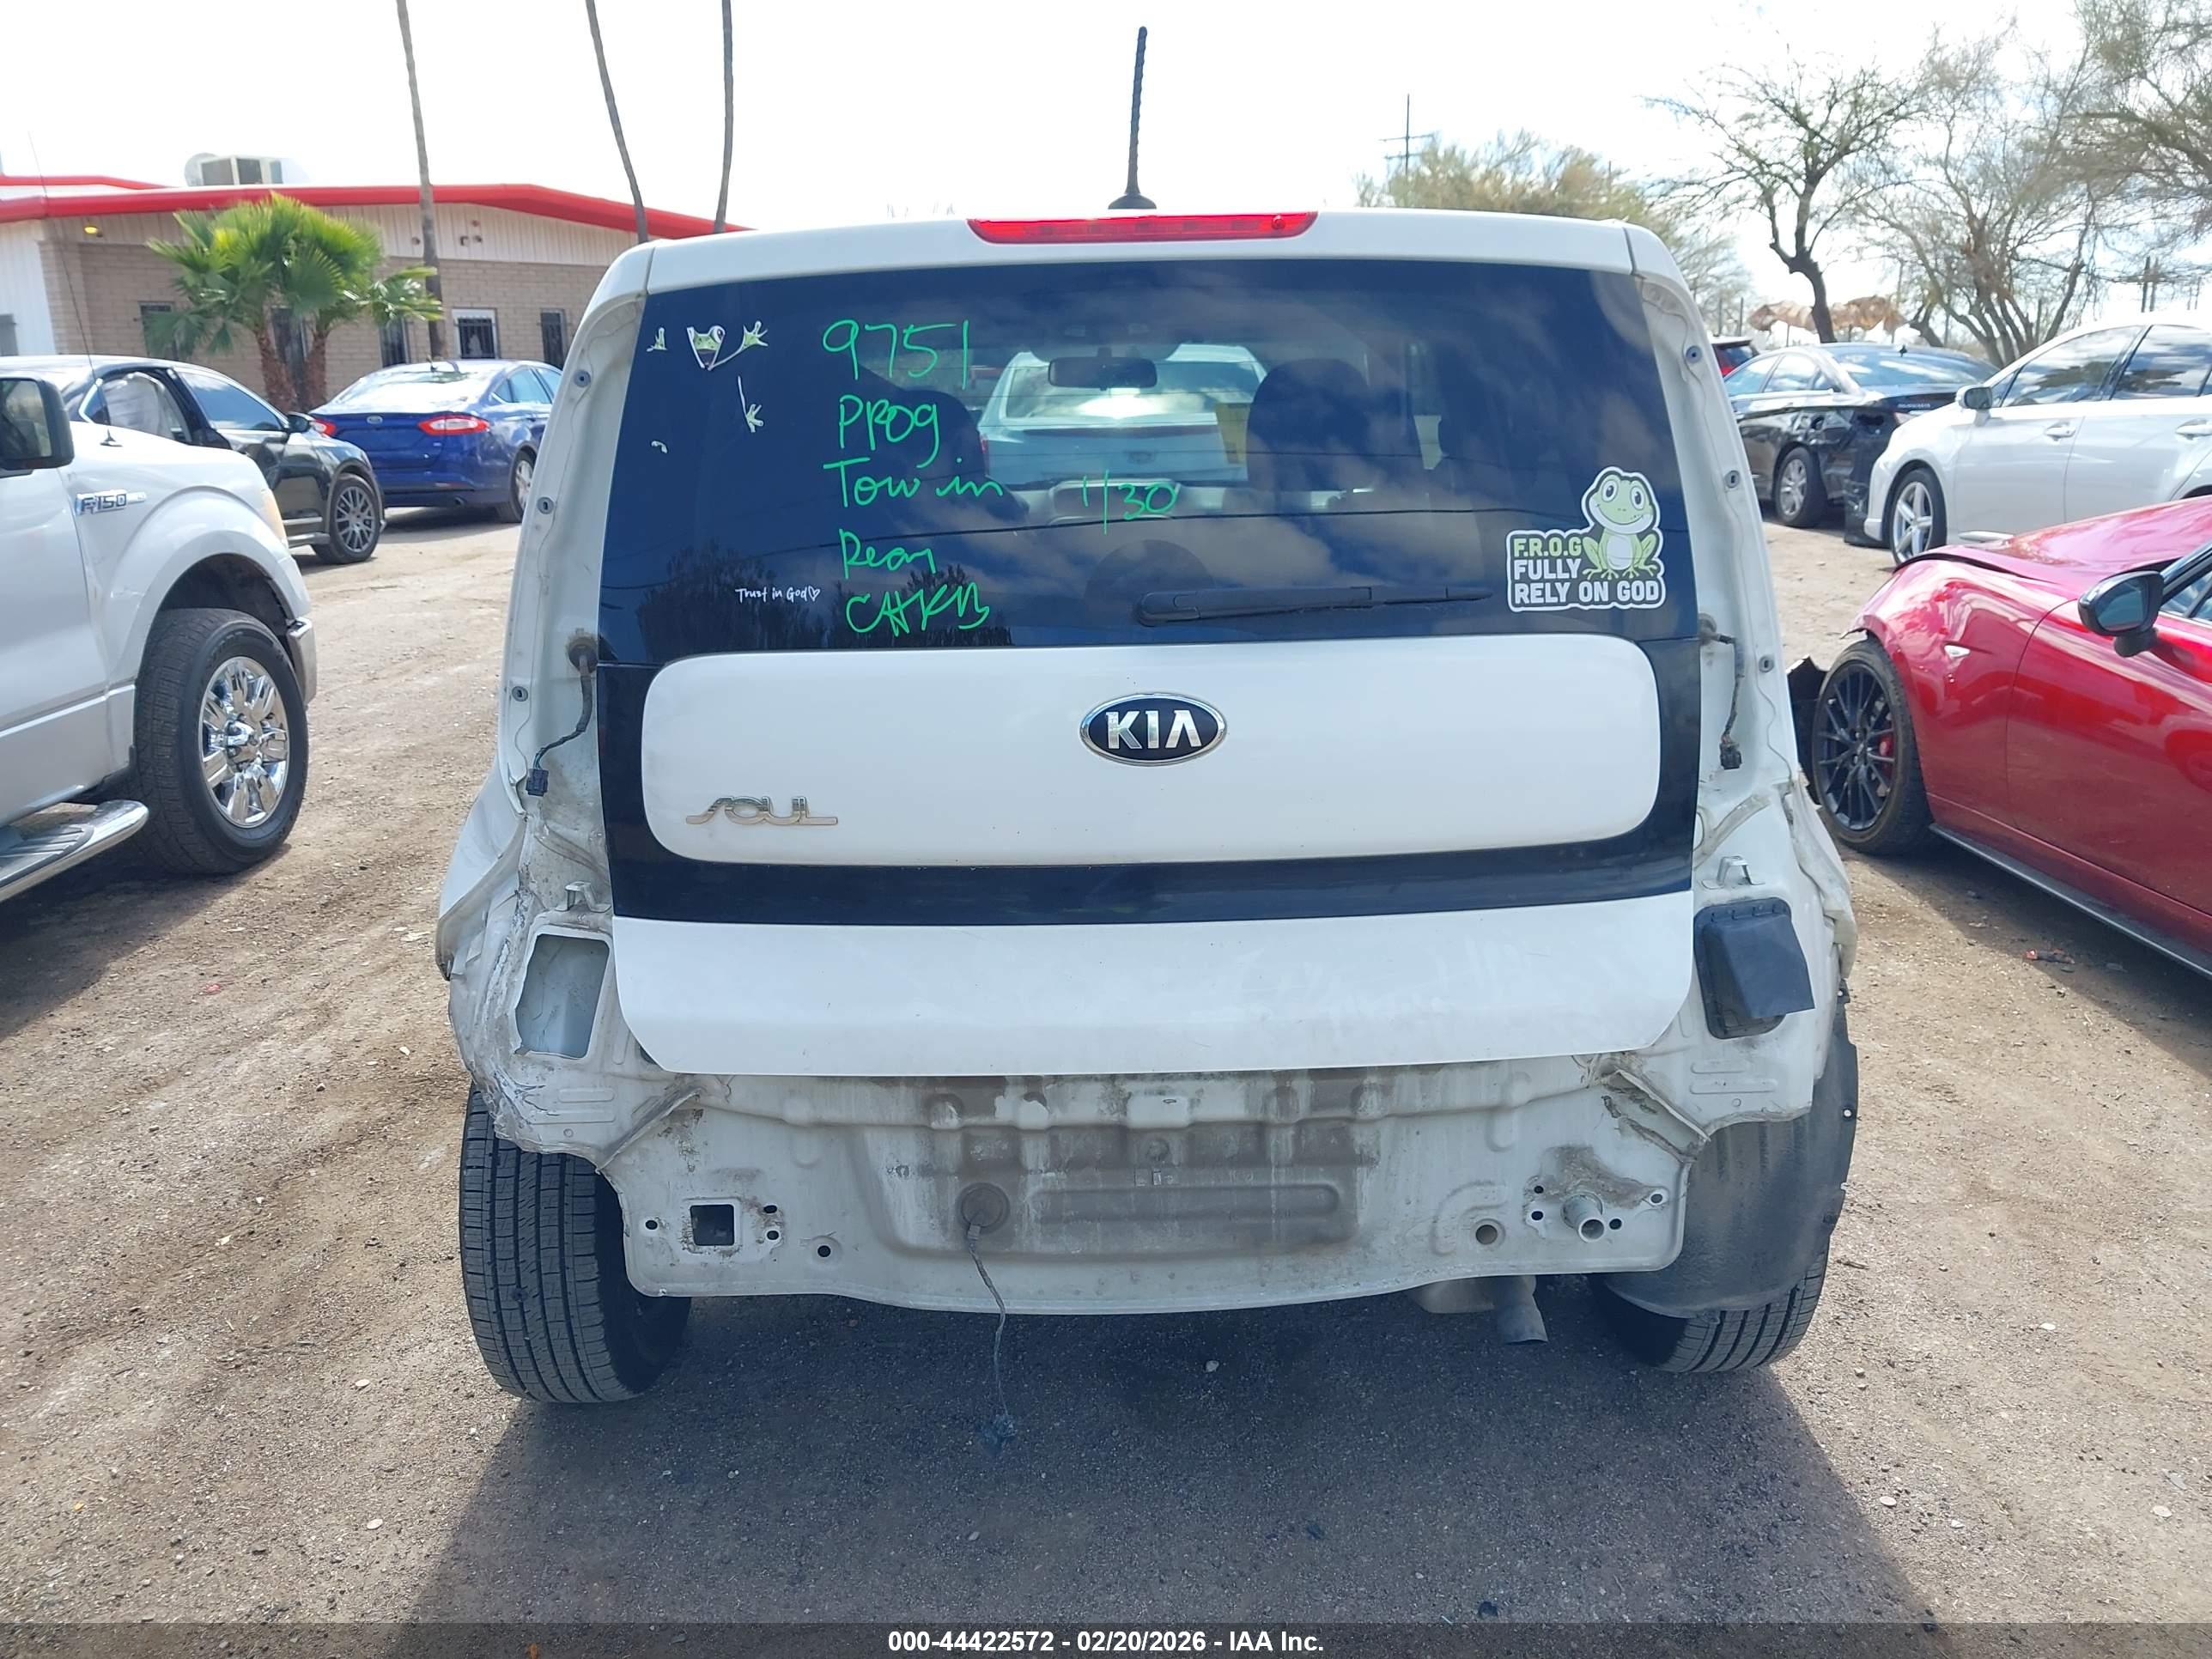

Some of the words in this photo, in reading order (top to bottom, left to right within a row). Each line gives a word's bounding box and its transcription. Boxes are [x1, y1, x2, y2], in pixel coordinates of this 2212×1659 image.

[823, 319, 969, 390] 9751
[823, 457, 921, 507] Tow
[935, 457, 1004, 497] in
[1082, 469, 1177, 536] 1/30
[839, 528, 937, 580] Rear
[1514, 558, 1582, 580] FULLY
[735, 586, 768, 604] Trust
[772, 586, 783, 600] in
[787, 586, 808, 604] God
[1514, 581, 1571, 605] RELY
[1578, 580, 1609, 602] ON
[1617, 580, 1659, 602] GOD
[1105, 709, 1202, 750] KIA
[685, 795, 839, 826] SOUL
